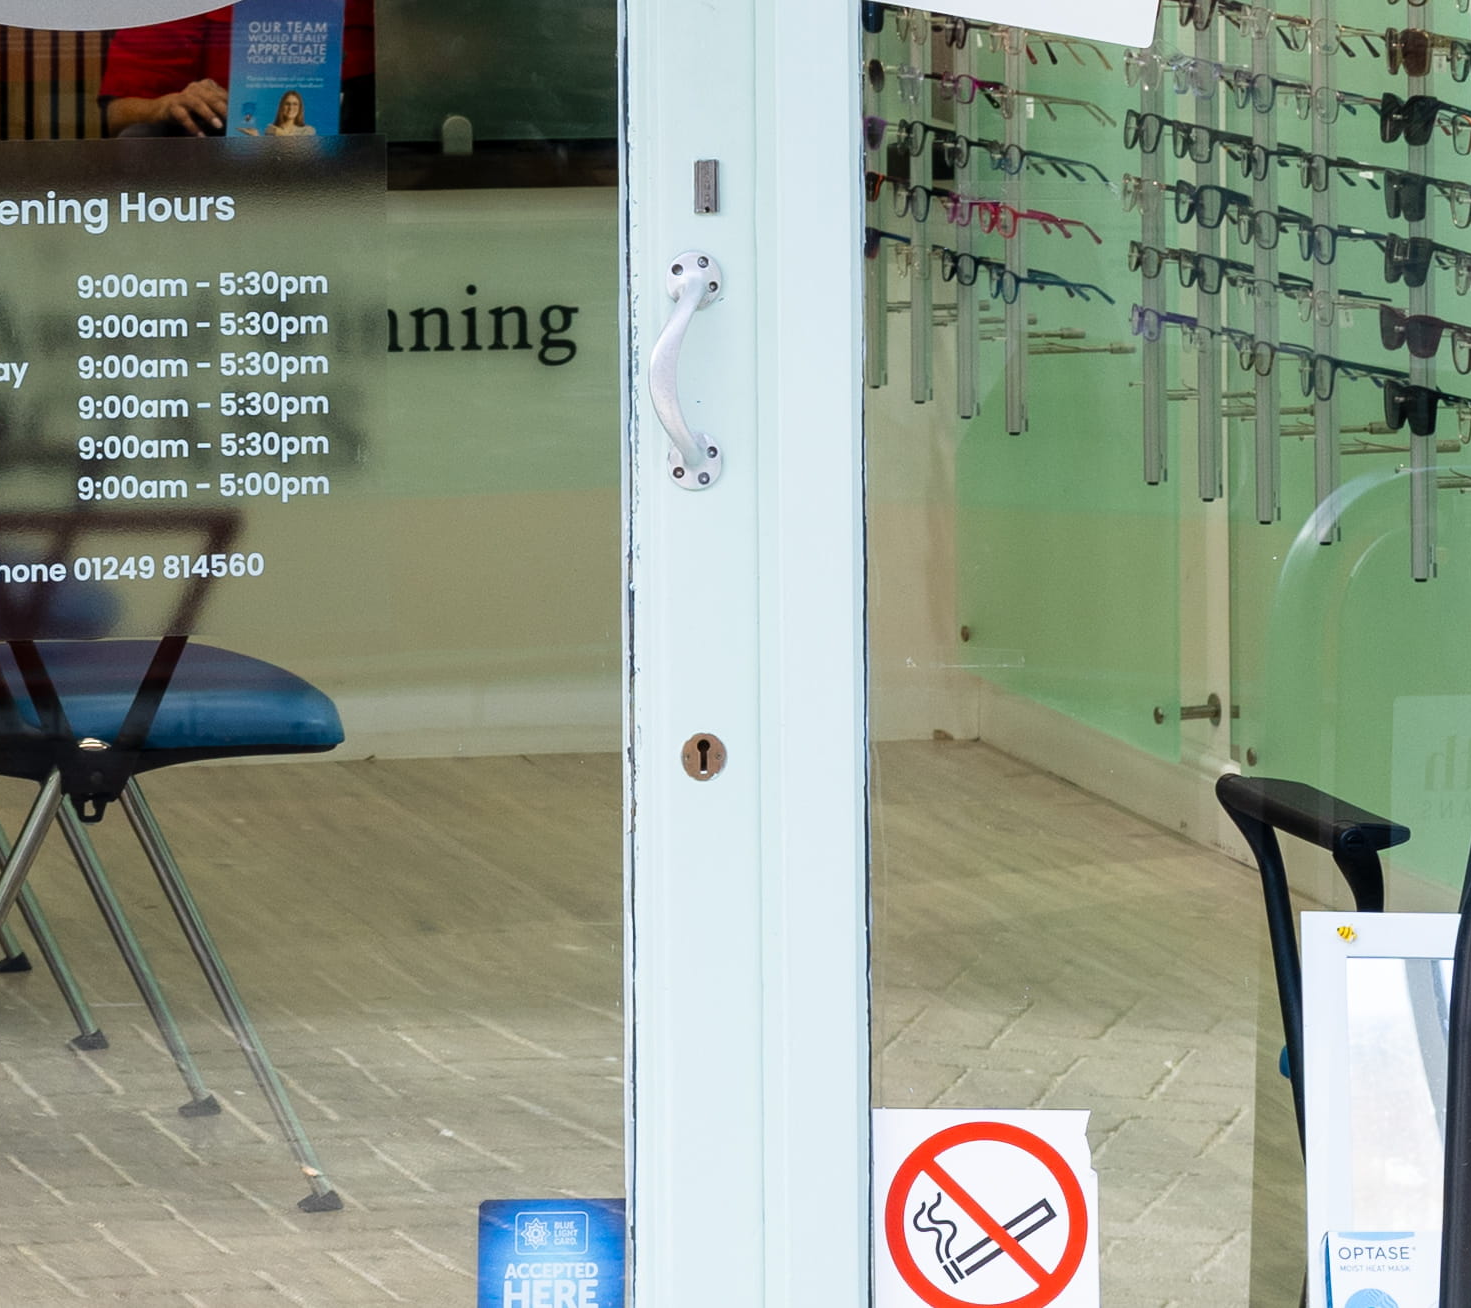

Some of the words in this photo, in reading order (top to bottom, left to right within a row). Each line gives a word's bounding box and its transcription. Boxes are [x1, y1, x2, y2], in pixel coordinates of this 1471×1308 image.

[249, 21, 282, 34] OUR
[287, 21, 328, 34] TEAM
[247, 44, 326, 56] APPRECIATE
[120, 192, 235, 223] Hours
[77, 274, 188, 299] 9:00am
[219, 270, 328, 302] 5:30pm
[77, 314, 188, 339] 9:00am
[219, 311, 329, 343] 5:30pm
[78, 354, 188, 380] 9:00am
[220, 351, 329, 383] 5:30pm
[78, 394, 189, 420] 9:00am
[220, 391, 329, 423] 5:30pm
[78, 434, 189, 460] 9:00am
[220, 431, 329, 463] 5:30pm
[77, 475, 188, 501] 9:00am
[219, 471, 330, 503] 5:00pm
[73, 555, 155, 581] 01249
[162, 552, 265, 579] 814560
[504, 1263, 598, 1279] ACCEPTED
[503, 1280, 599, 1308] HERE
